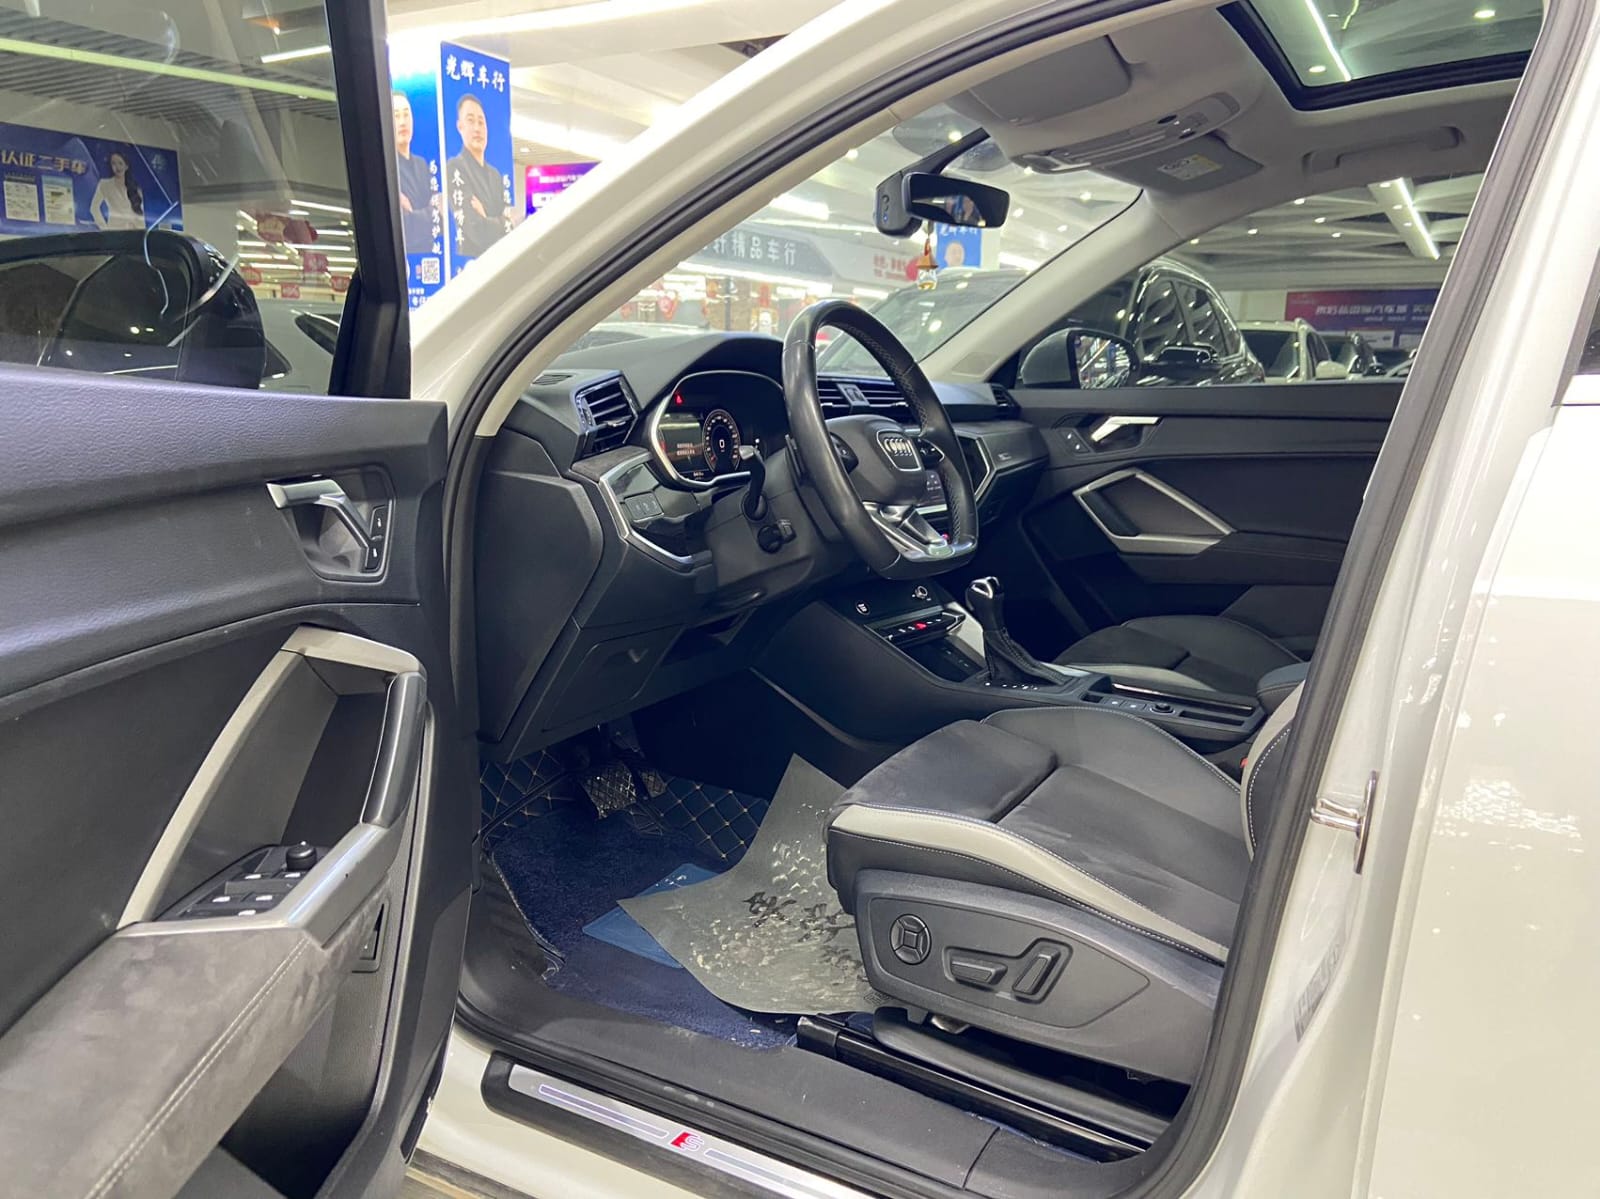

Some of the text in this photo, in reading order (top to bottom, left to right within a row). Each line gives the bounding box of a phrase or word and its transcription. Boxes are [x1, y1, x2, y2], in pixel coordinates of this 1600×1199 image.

[446, 53, 506, 93] 光辉车行
[1, 149, 88, 175] 认证二手车
[703, 229, 797, 266] 轩精品车行
